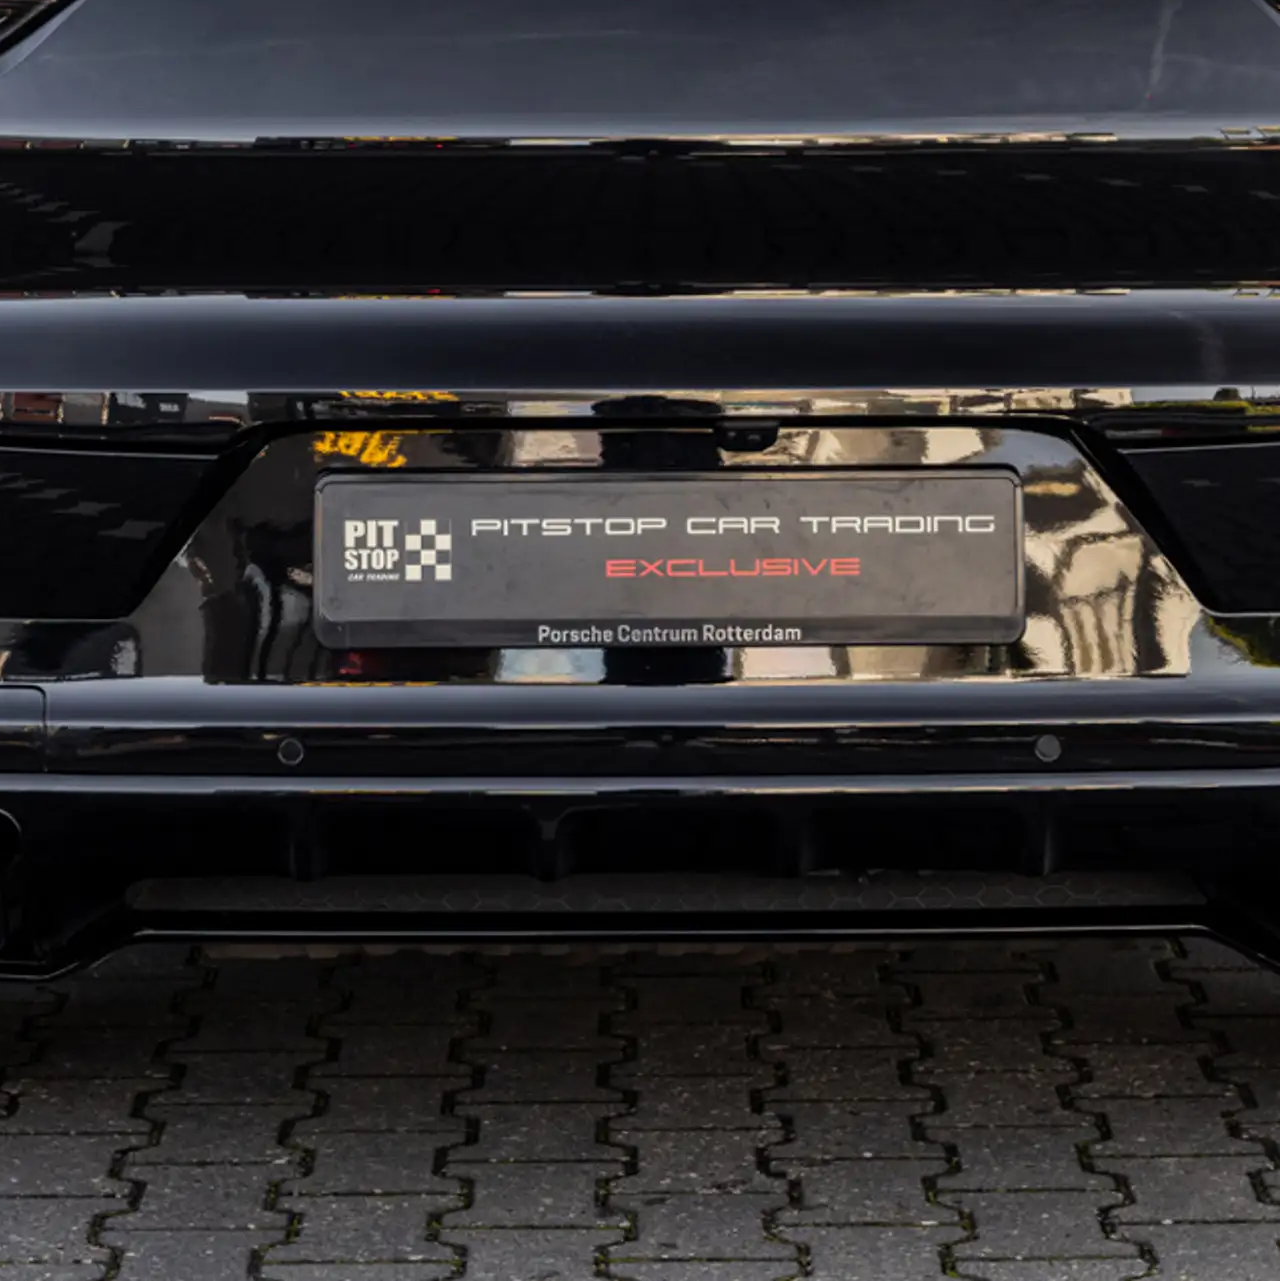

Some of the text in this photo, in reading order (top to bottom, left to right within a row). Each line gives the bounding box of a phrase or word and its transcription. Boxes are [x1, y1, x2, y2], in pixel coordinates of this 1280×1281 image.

[344, 519, 399, 548] PIT
[471, 515, 995, 536] PITSTOP CAR TRADING
[344, 549, 400, 570] STOP
[605, 557, 861, 578] EXCLUSIVE
[537, 623, 802, 643] Porsche Centrum Rotterdam
